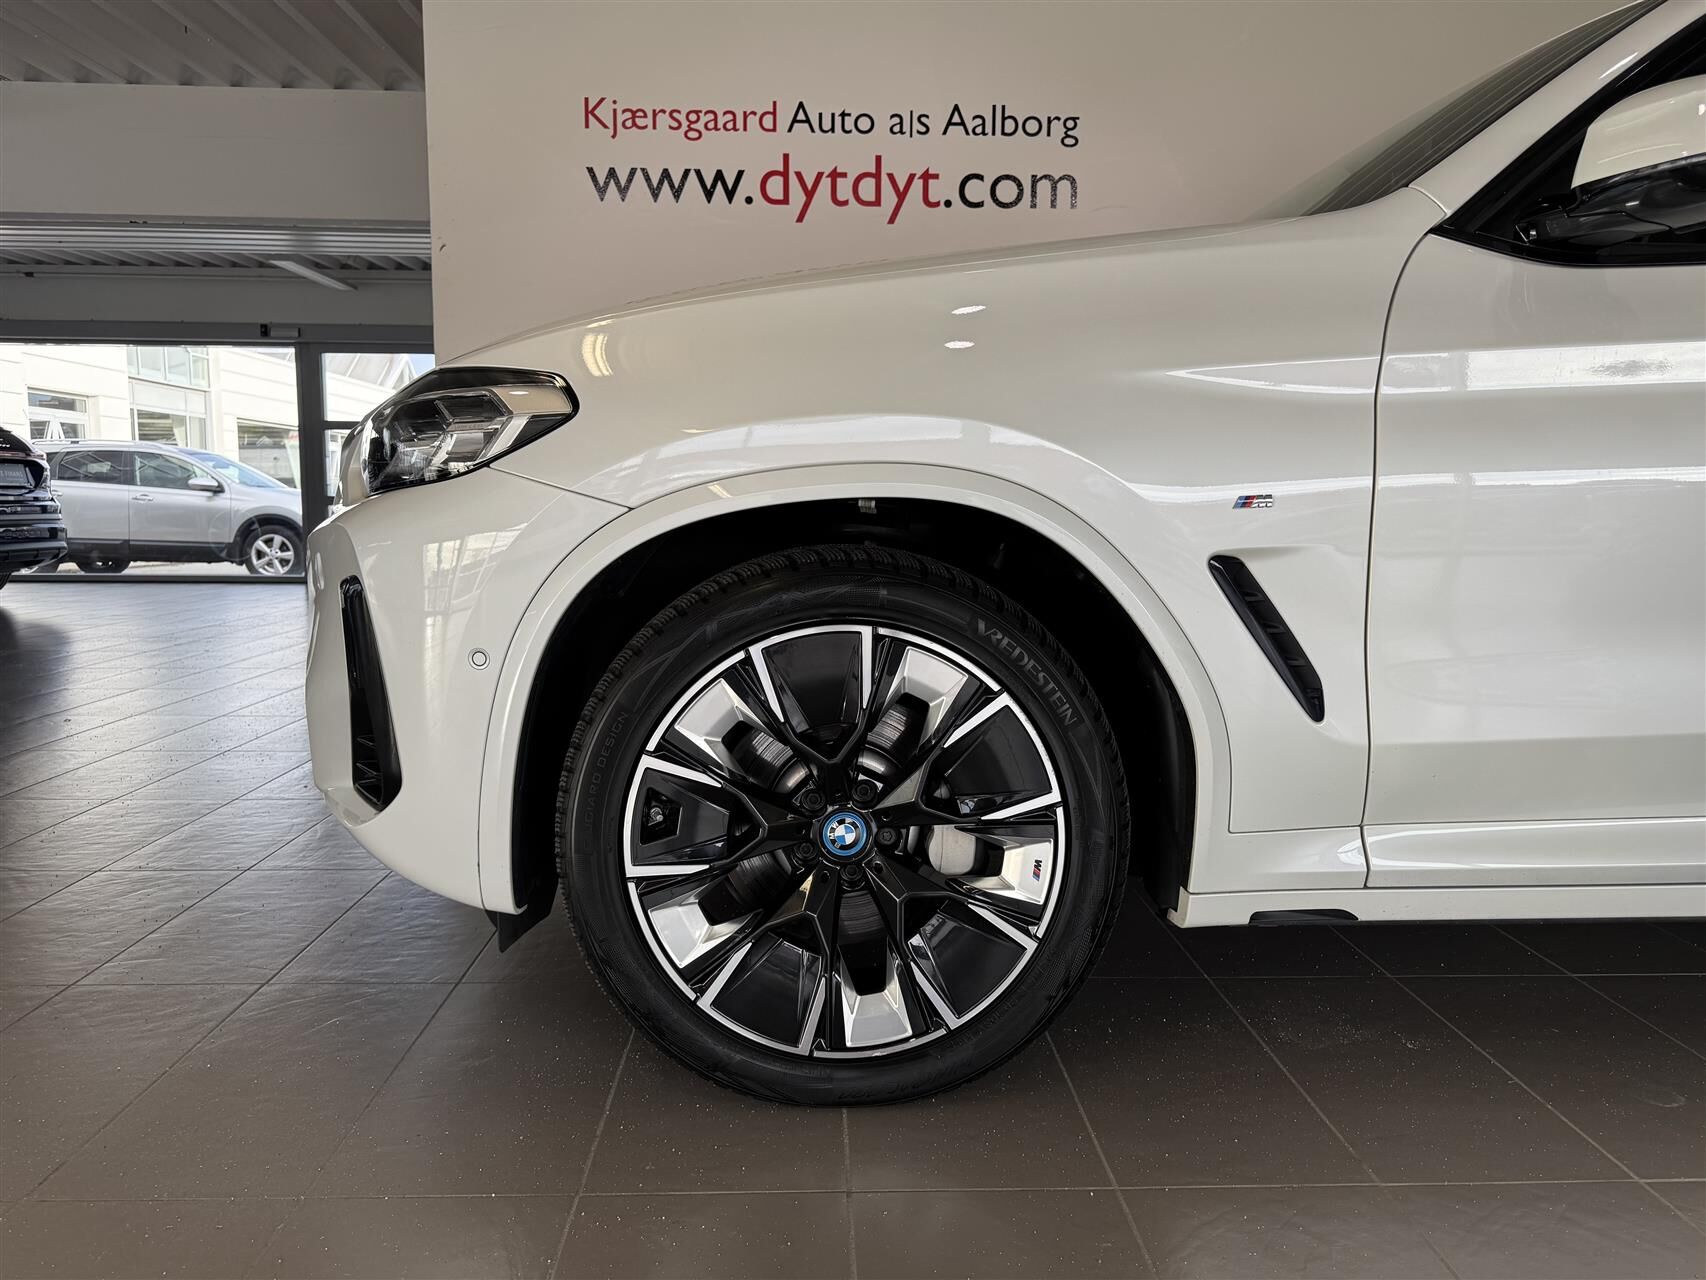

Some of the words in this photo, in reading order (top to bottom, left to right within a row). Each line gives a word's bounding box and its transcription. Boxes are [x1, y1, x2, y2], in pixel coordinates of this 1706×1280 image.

[583, 97, 778, 140] Kjærsgaard
[787, 101, 875, 135] Auto
[942, 103, 1081, 148] Aalborg
[586, 153, 1079, 225] www.dytdyt.com
[978, 619, 1077, 725] VREDESTEIN
[597, 711, 629, 768] DESIGN
